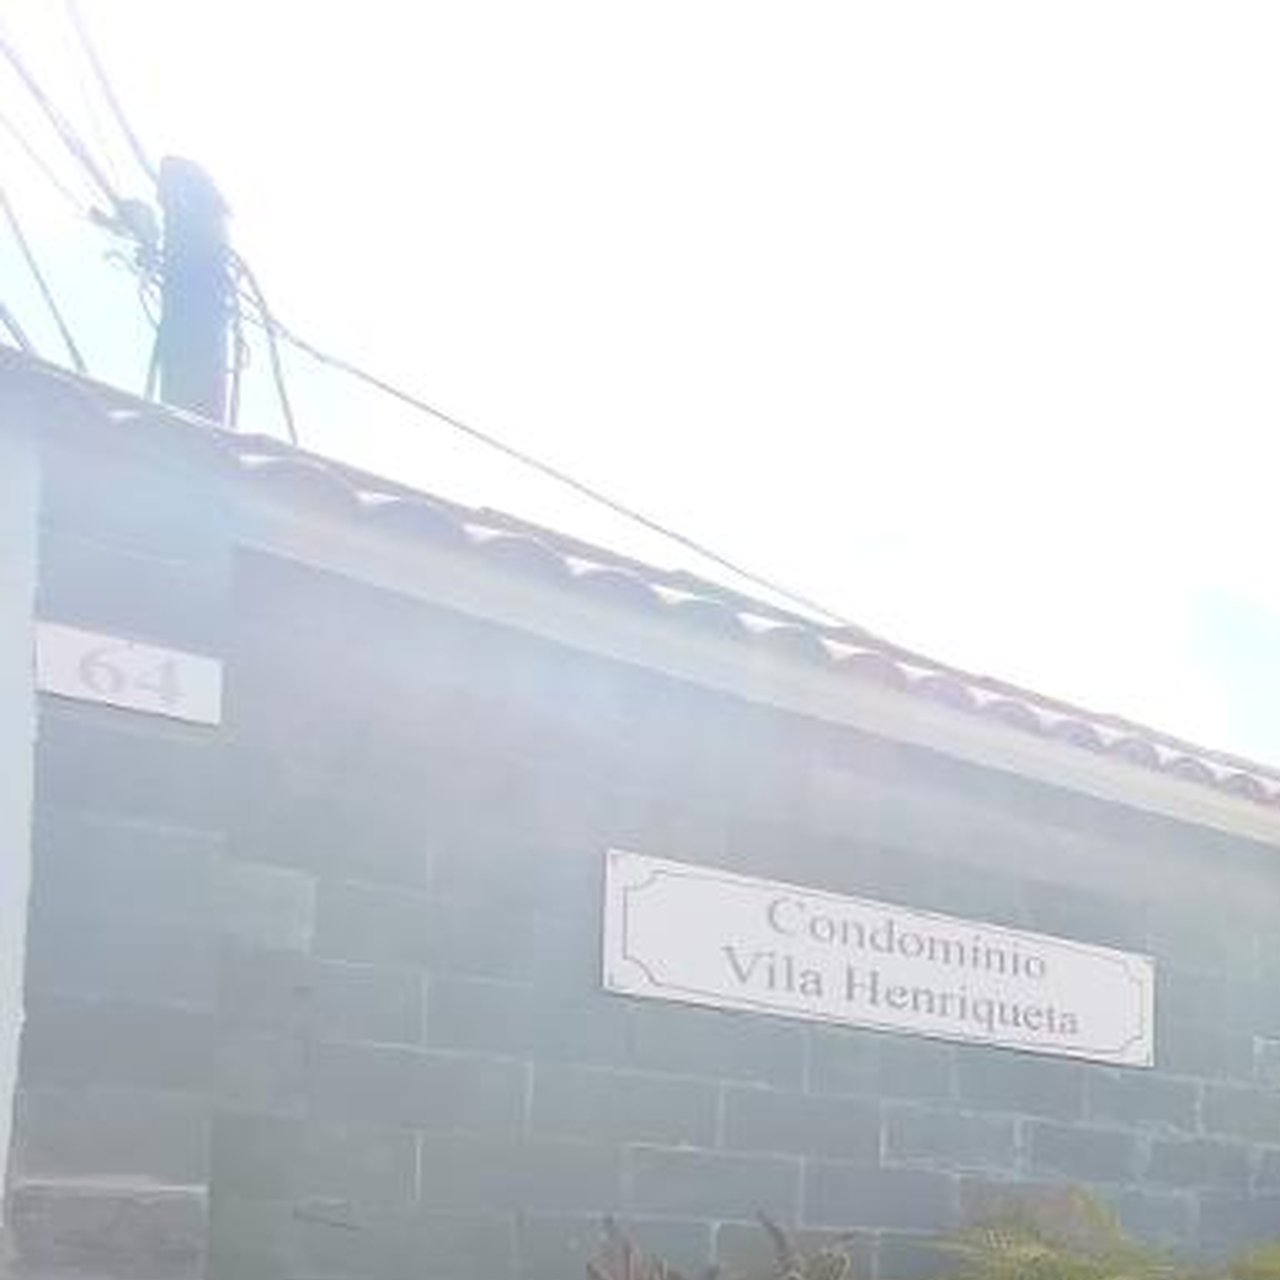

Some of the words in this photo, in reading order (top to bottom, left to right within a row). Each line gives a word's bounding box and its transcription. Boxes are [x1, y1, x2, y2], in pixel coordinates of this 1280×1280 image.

[78, 648, 184, 704] 64
[721, 944, 824, 998] Vila
[844, 964, 1079, 1036] Henriqueta
